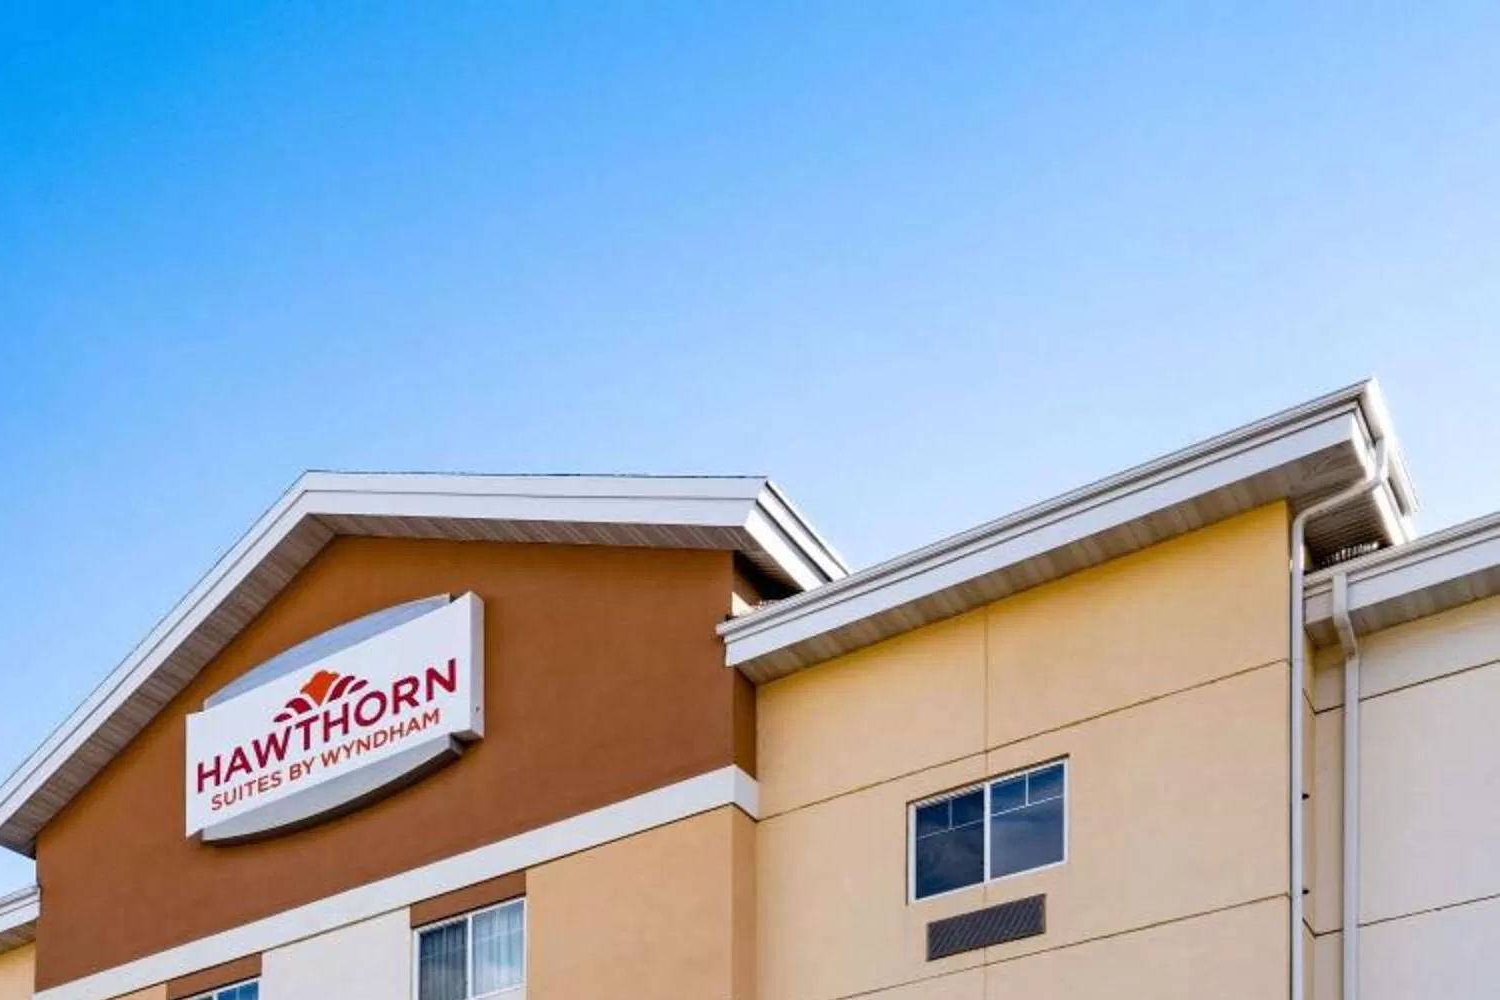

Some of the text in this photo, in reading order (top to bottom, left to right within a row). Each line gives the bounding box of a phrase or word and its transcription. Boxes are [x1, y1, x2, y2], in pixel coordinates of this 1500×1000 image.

[197, 658, 456, 793] HAWTHORN
[211, 708, 440, 811] SUITES BY WYNDHAM
